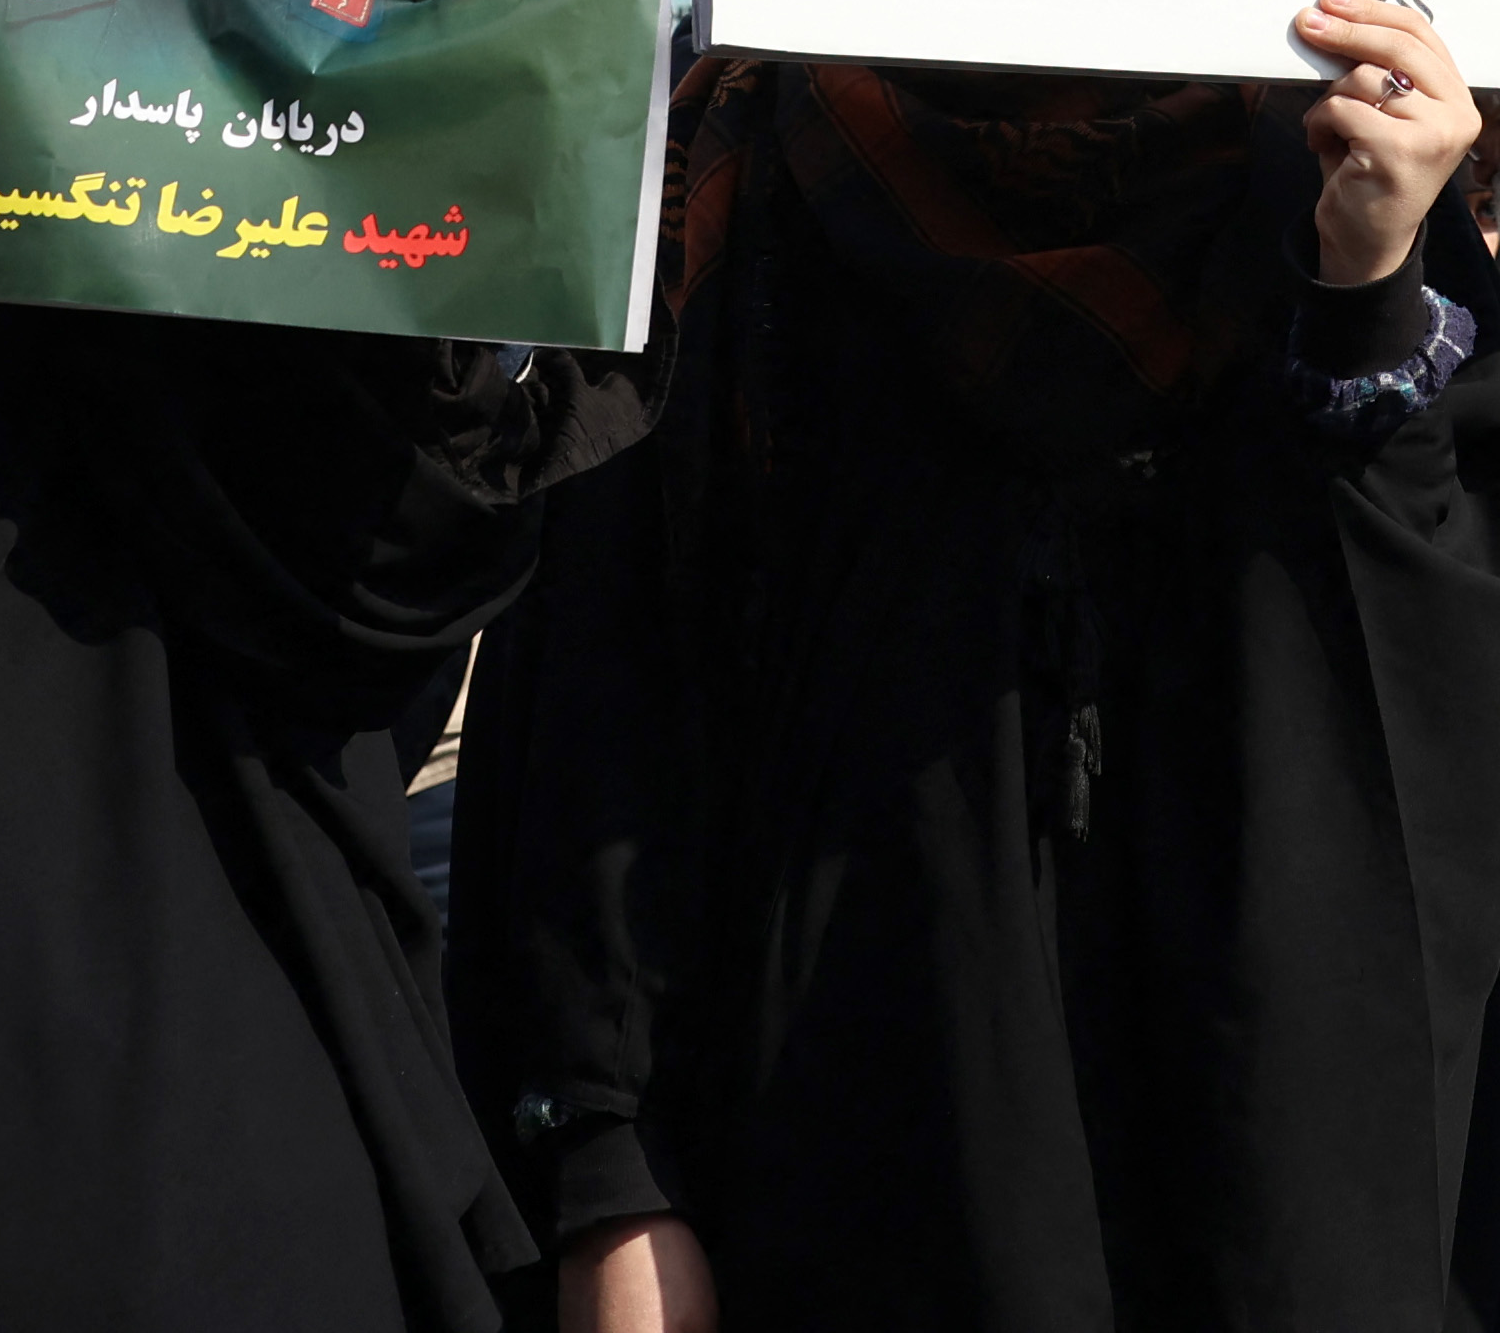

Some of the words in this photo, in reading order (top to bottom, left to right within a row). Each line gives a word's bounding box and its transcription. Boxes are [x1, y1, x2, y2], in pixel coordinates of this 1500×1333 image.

[70, 78, 204, 145] پاسدار
[221, 100, 364, 155] دریابان
[156, 182, 328, 259] علیرضا
[344, 206, 468, 268] شهید
